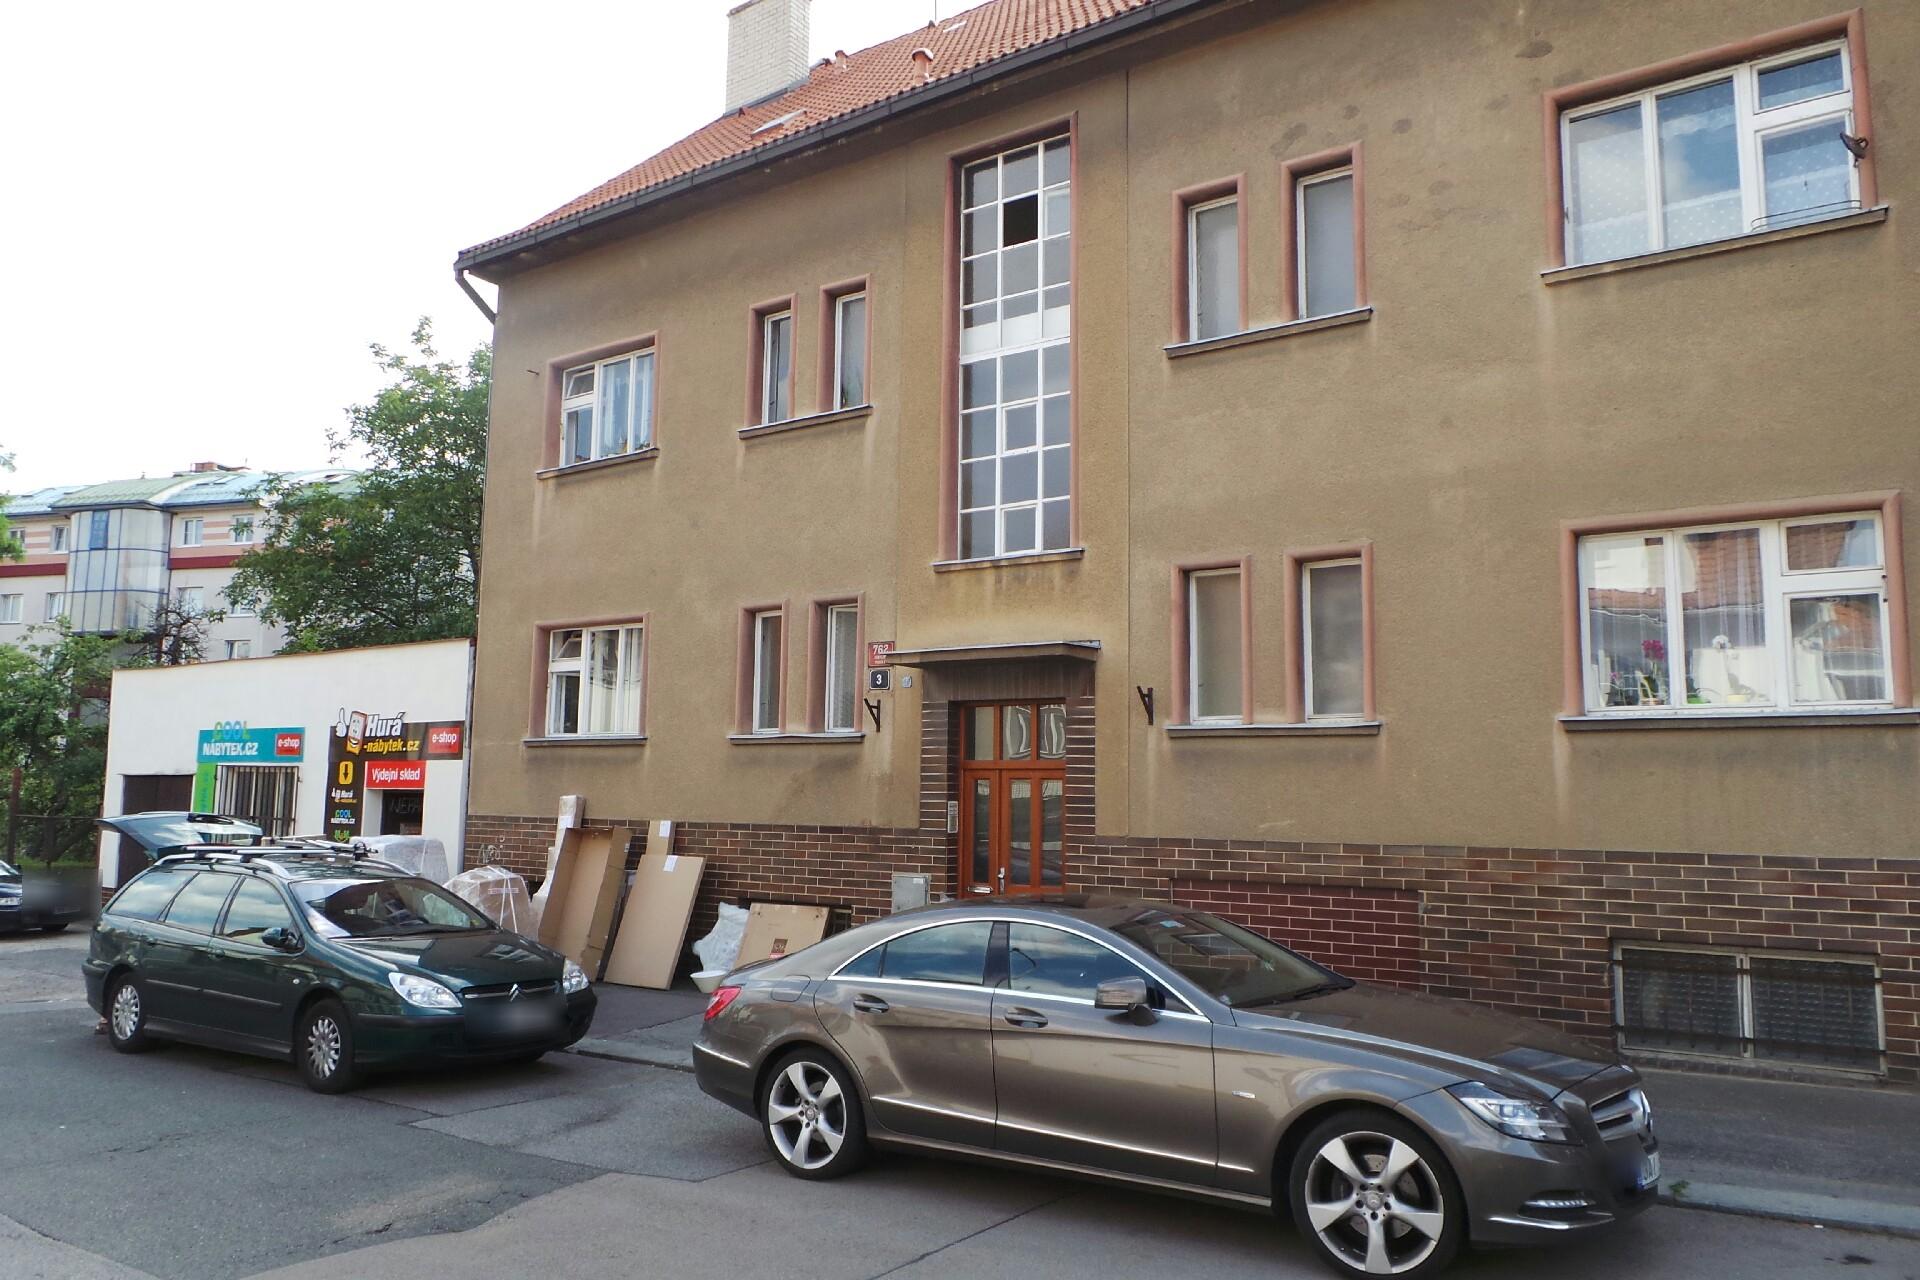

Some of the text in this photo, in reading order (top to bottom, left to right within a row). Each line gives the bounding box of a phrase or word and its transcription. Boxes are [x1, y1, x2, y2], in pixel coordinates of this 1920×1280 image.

[873, 644, 888, 654] 762
[876, 674, 882, 685] 3
[213, 720, 251, 740] COOL
[365, 711, 406, 737] Hurá
[278, 737, 300, 749] e-shop
[432, 731, 457, 745] e-shop
[203, 740, 258, 755] NÁBYTEK.CZ
[372, 768, 420, 783] Výdejní sklad
